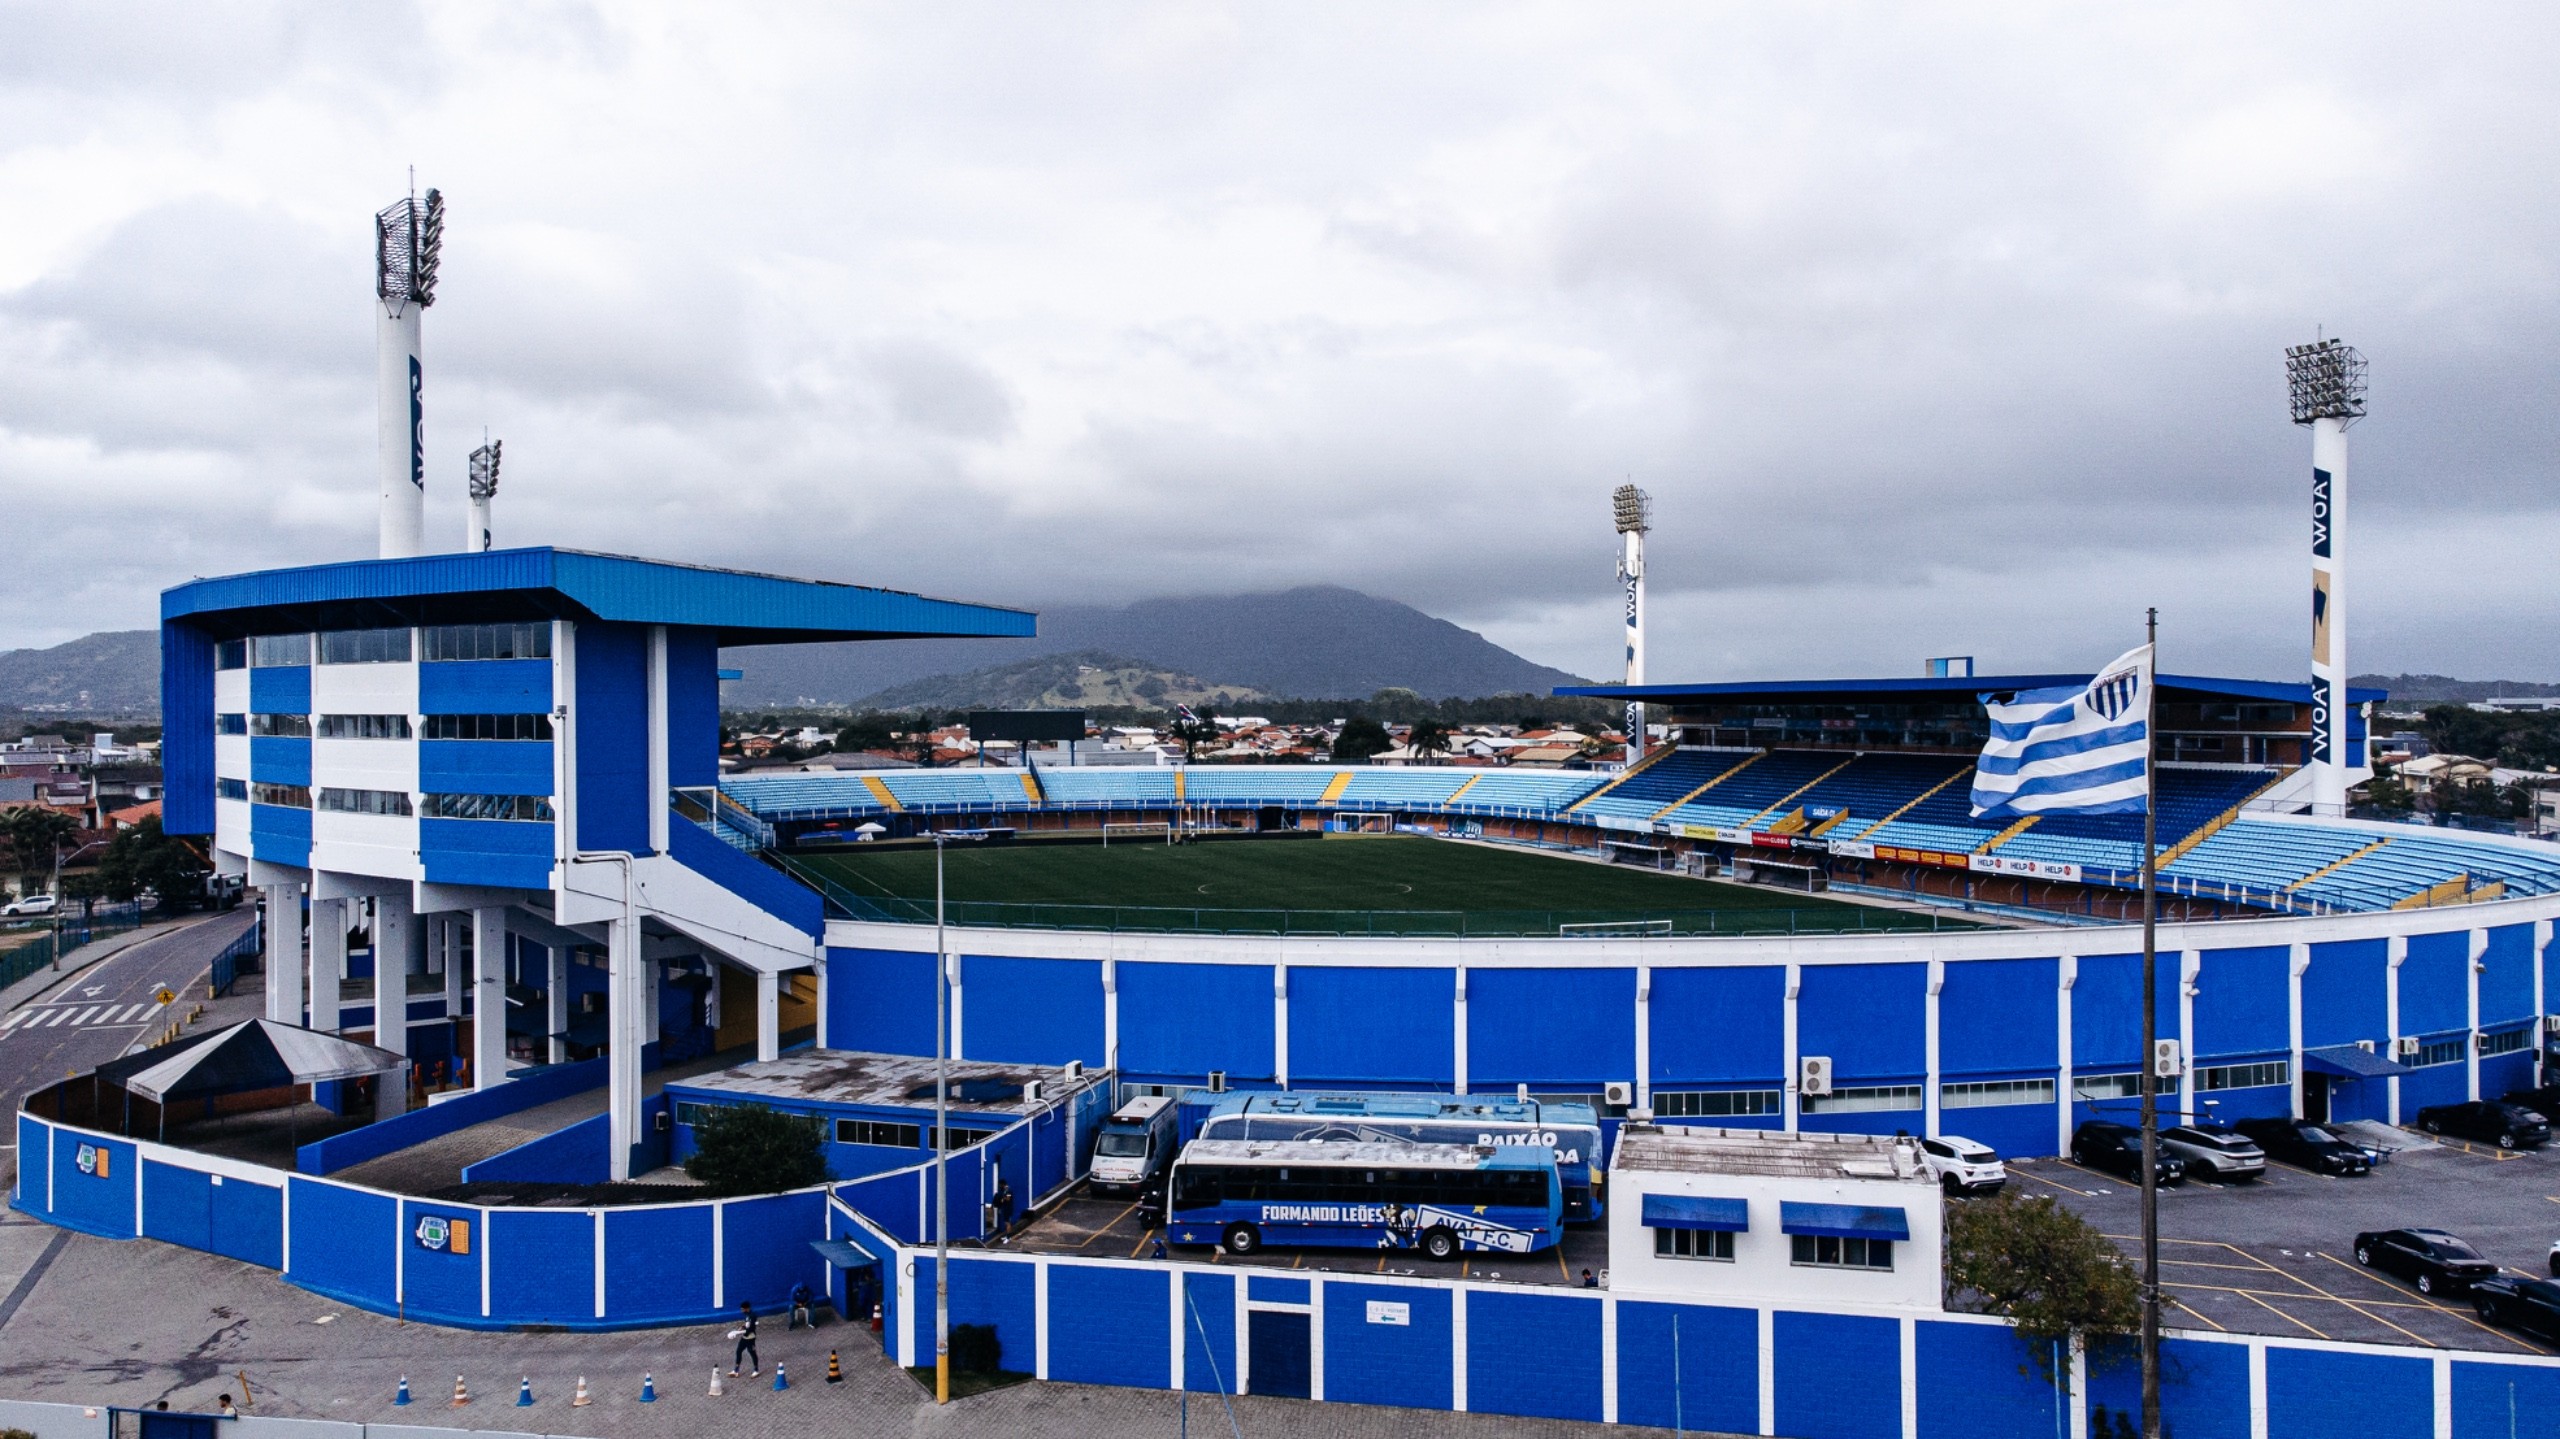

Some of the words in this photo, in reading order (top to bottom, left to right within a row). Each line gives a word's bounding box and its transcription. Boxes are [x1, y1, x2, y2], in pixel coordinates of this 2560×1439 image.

[2313, 480, 2328, 547] WOA
[1627, 702, 1635, 740] WOA
[2313, 686, 2328, 756] WOA
[1977, 858, 1994, 867] HELP
[2010, 861, 2028, 871] HELP
[2044, 865, 2063, 874] HELP
[1262, 1205, 1340, 1221] FORMANDO
[1342, 1204, 1385, 1223] LEÕES
[1483, 1230, 1514, 1249] F.C.
